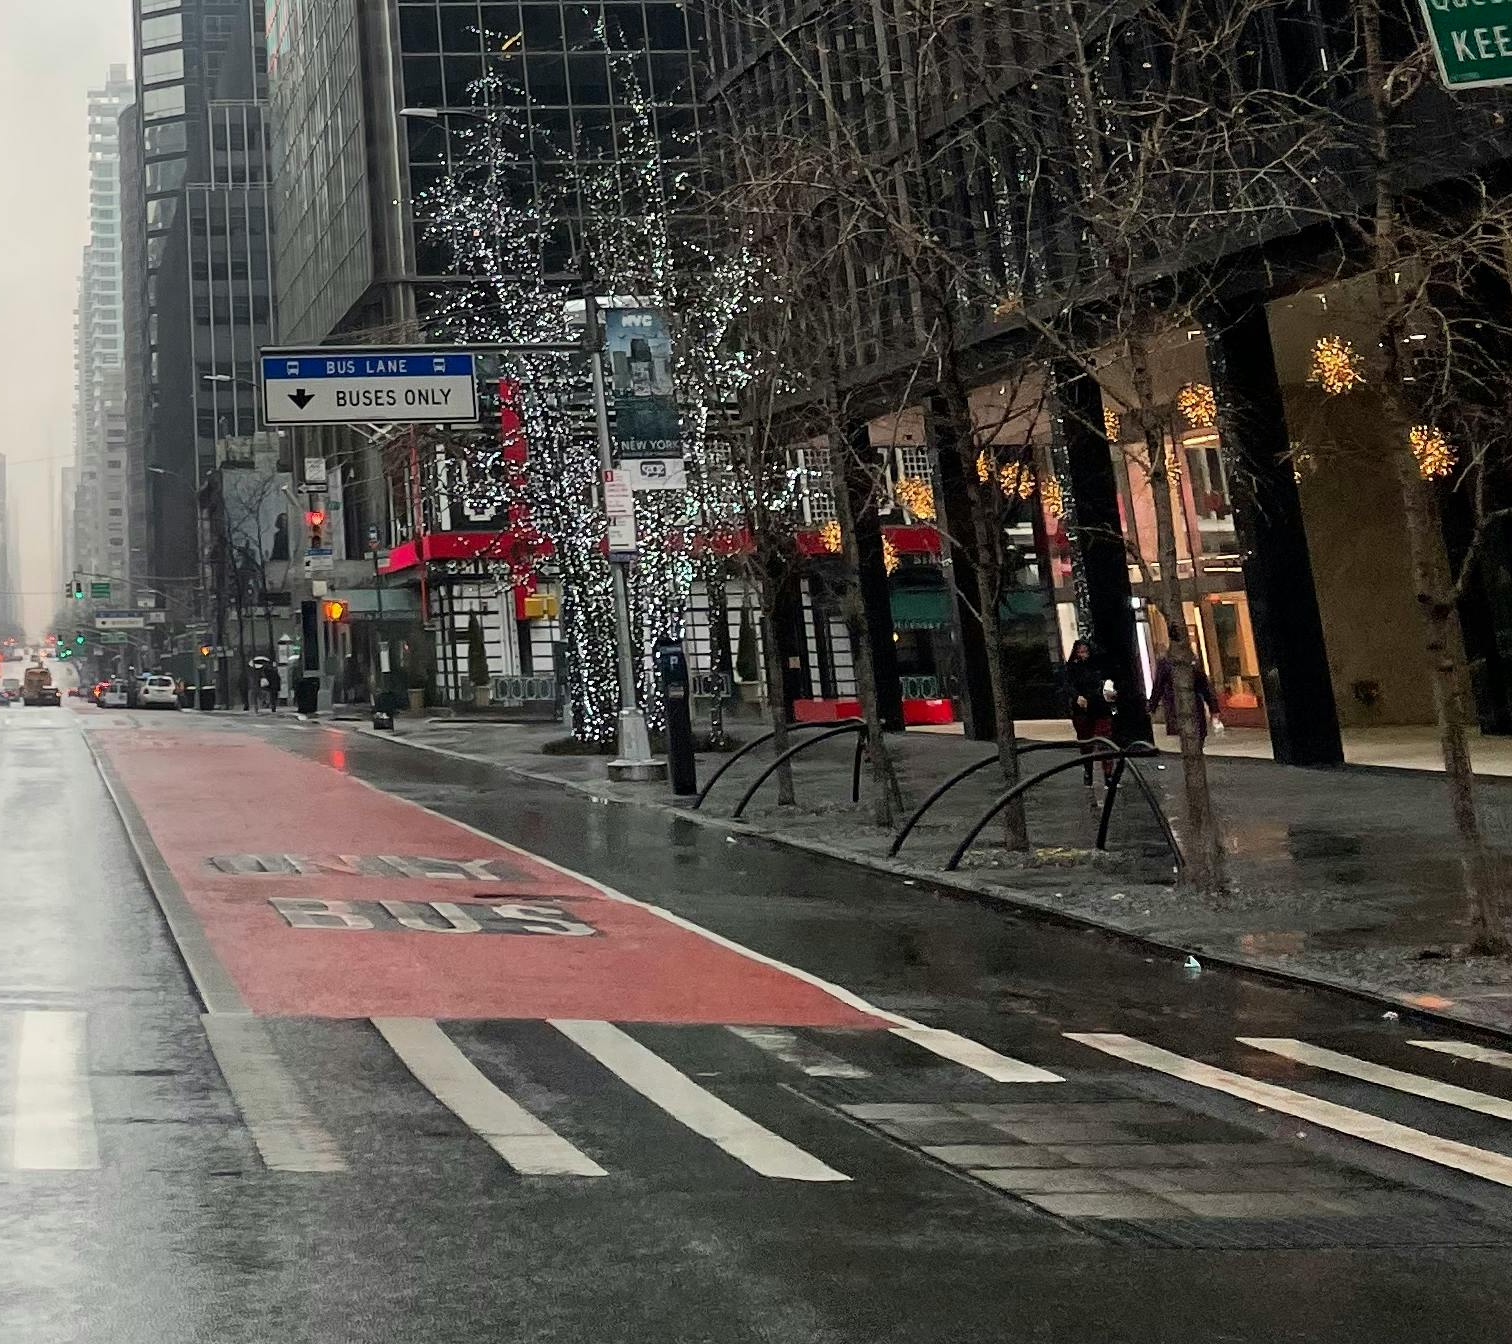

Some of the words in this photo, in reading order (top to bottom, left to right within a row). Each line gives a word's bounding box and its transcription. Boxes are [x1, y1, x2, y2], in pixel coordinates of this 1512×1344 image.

[621, 314, 653, 327] NYC
[326, 360, 356, 375] BUS
[365, 359, 408, 374] LANE
[336, 389, 397, 407] BUSES
[404, 388, 452, 406] ONLY
[620, 439, 647, 451] NEW
[649, 439, 679, 450] YORK
[267, 896, 597, 936] BUS
